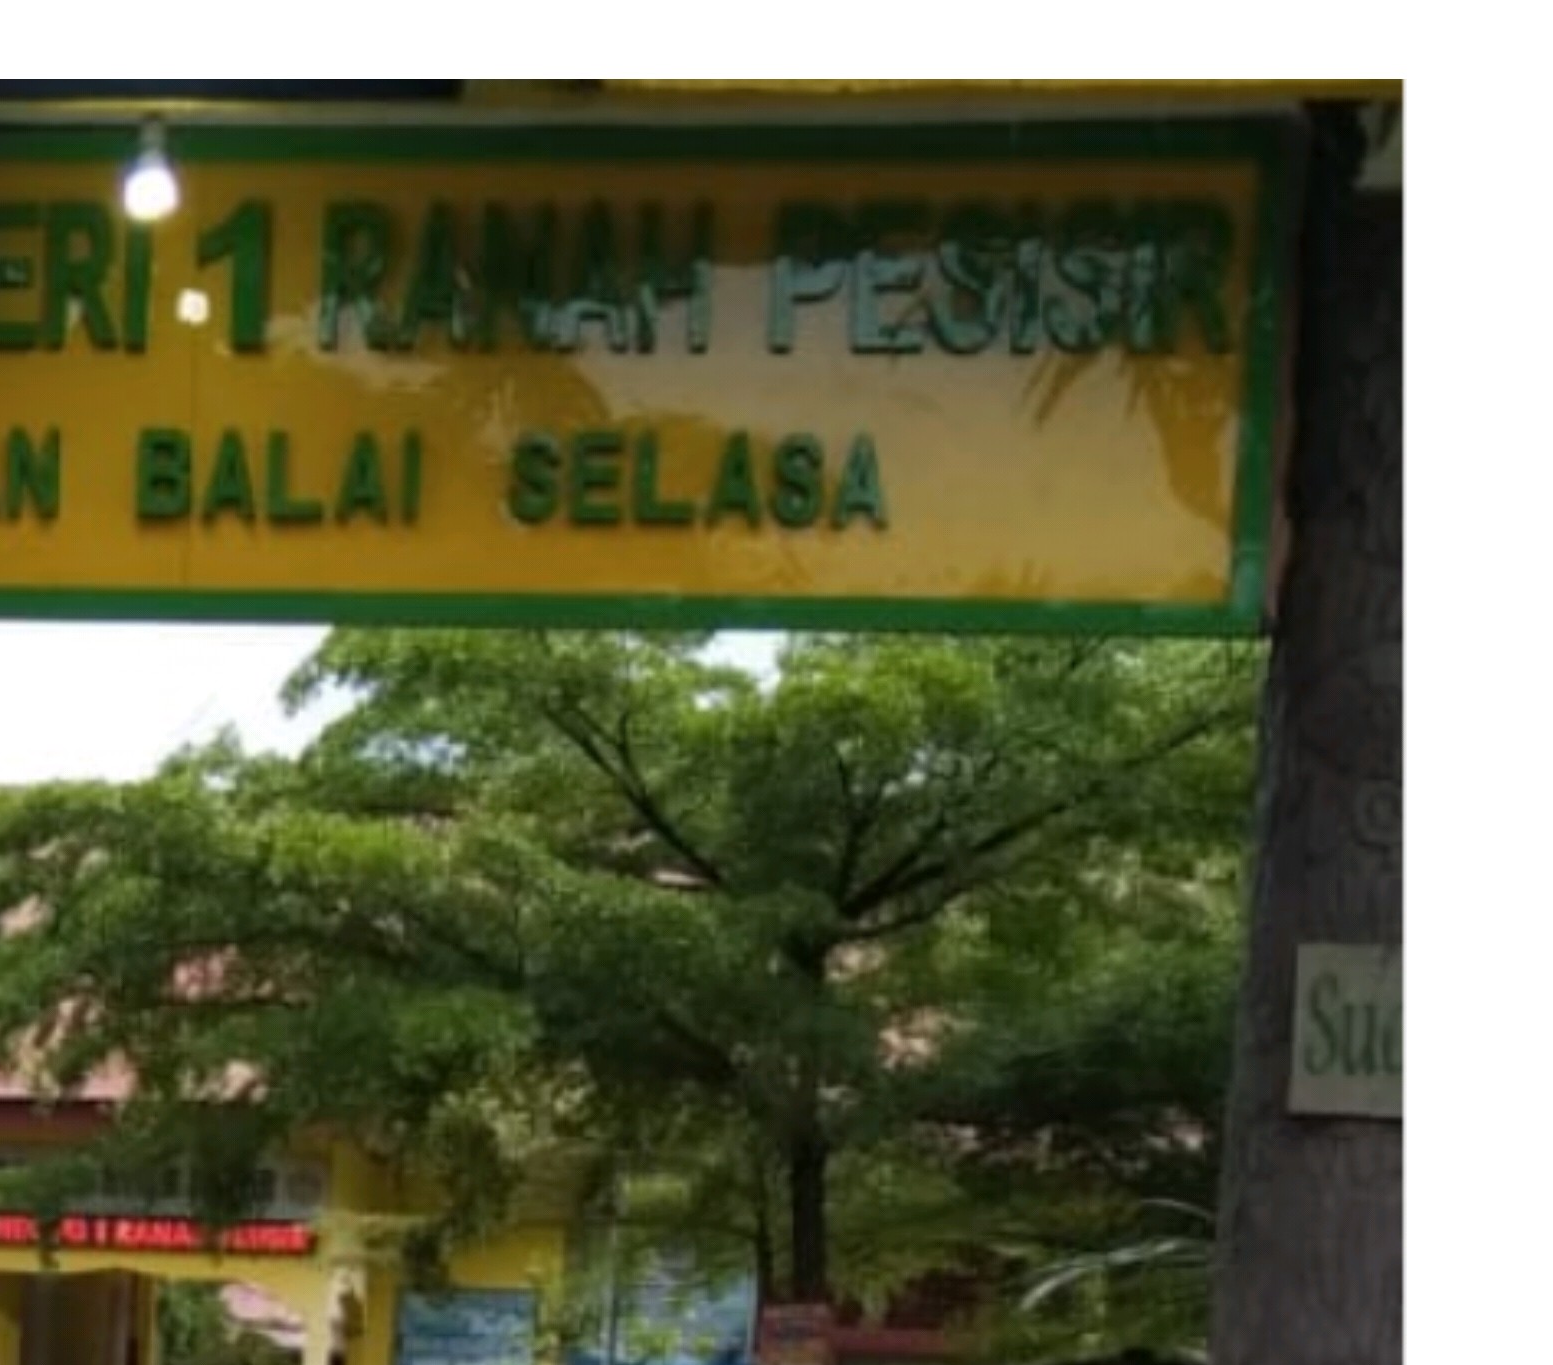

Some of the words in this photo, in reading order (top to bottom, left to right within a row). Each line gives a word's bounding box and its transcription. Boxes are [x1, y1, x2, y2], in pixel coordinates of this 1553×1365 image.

[197, 198, 275, 356] 1
[317, 198, 713, 357] RANAH
[765, 198, 1235, 358] PESISIR
[132, 427, 424, 528] BALAI
[505, 429, 889, 530] SELASA
